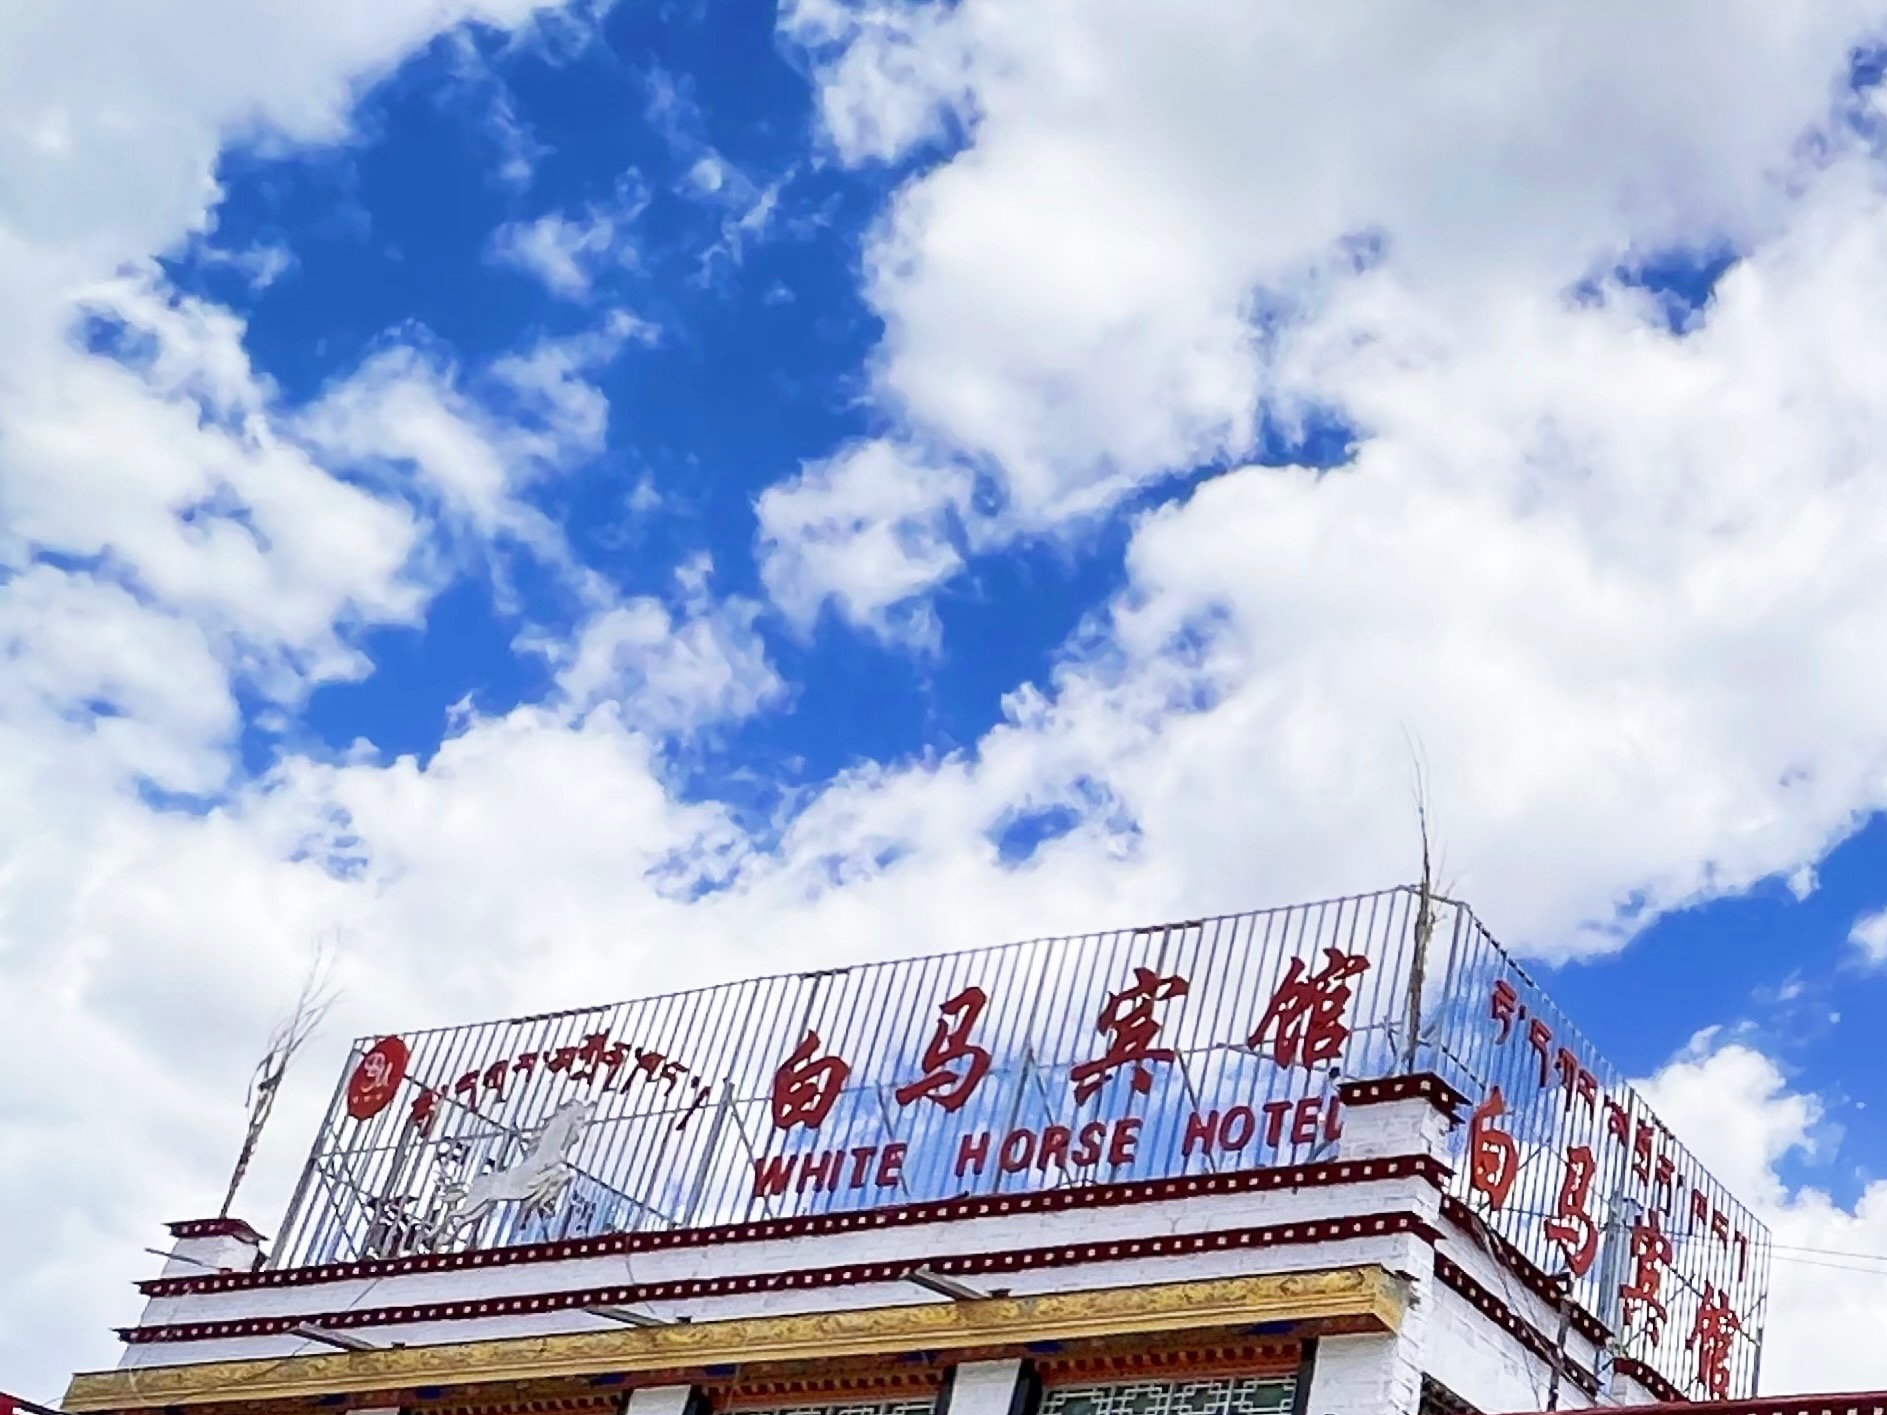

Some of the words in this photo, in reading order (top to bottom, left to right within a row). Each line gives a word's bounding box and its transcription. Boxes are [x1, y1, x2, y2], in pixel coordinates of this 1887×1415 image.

[771, 946, 1370, 1131] 白马宾馆
[753, 1143, 909, 1198] WHITE
[956, 1117, 1143, 1177] HORSE
[1182, 1095, 1344, 1158] HOTEL
[1470, 1085, 1742, 1401] 白马宾馆
